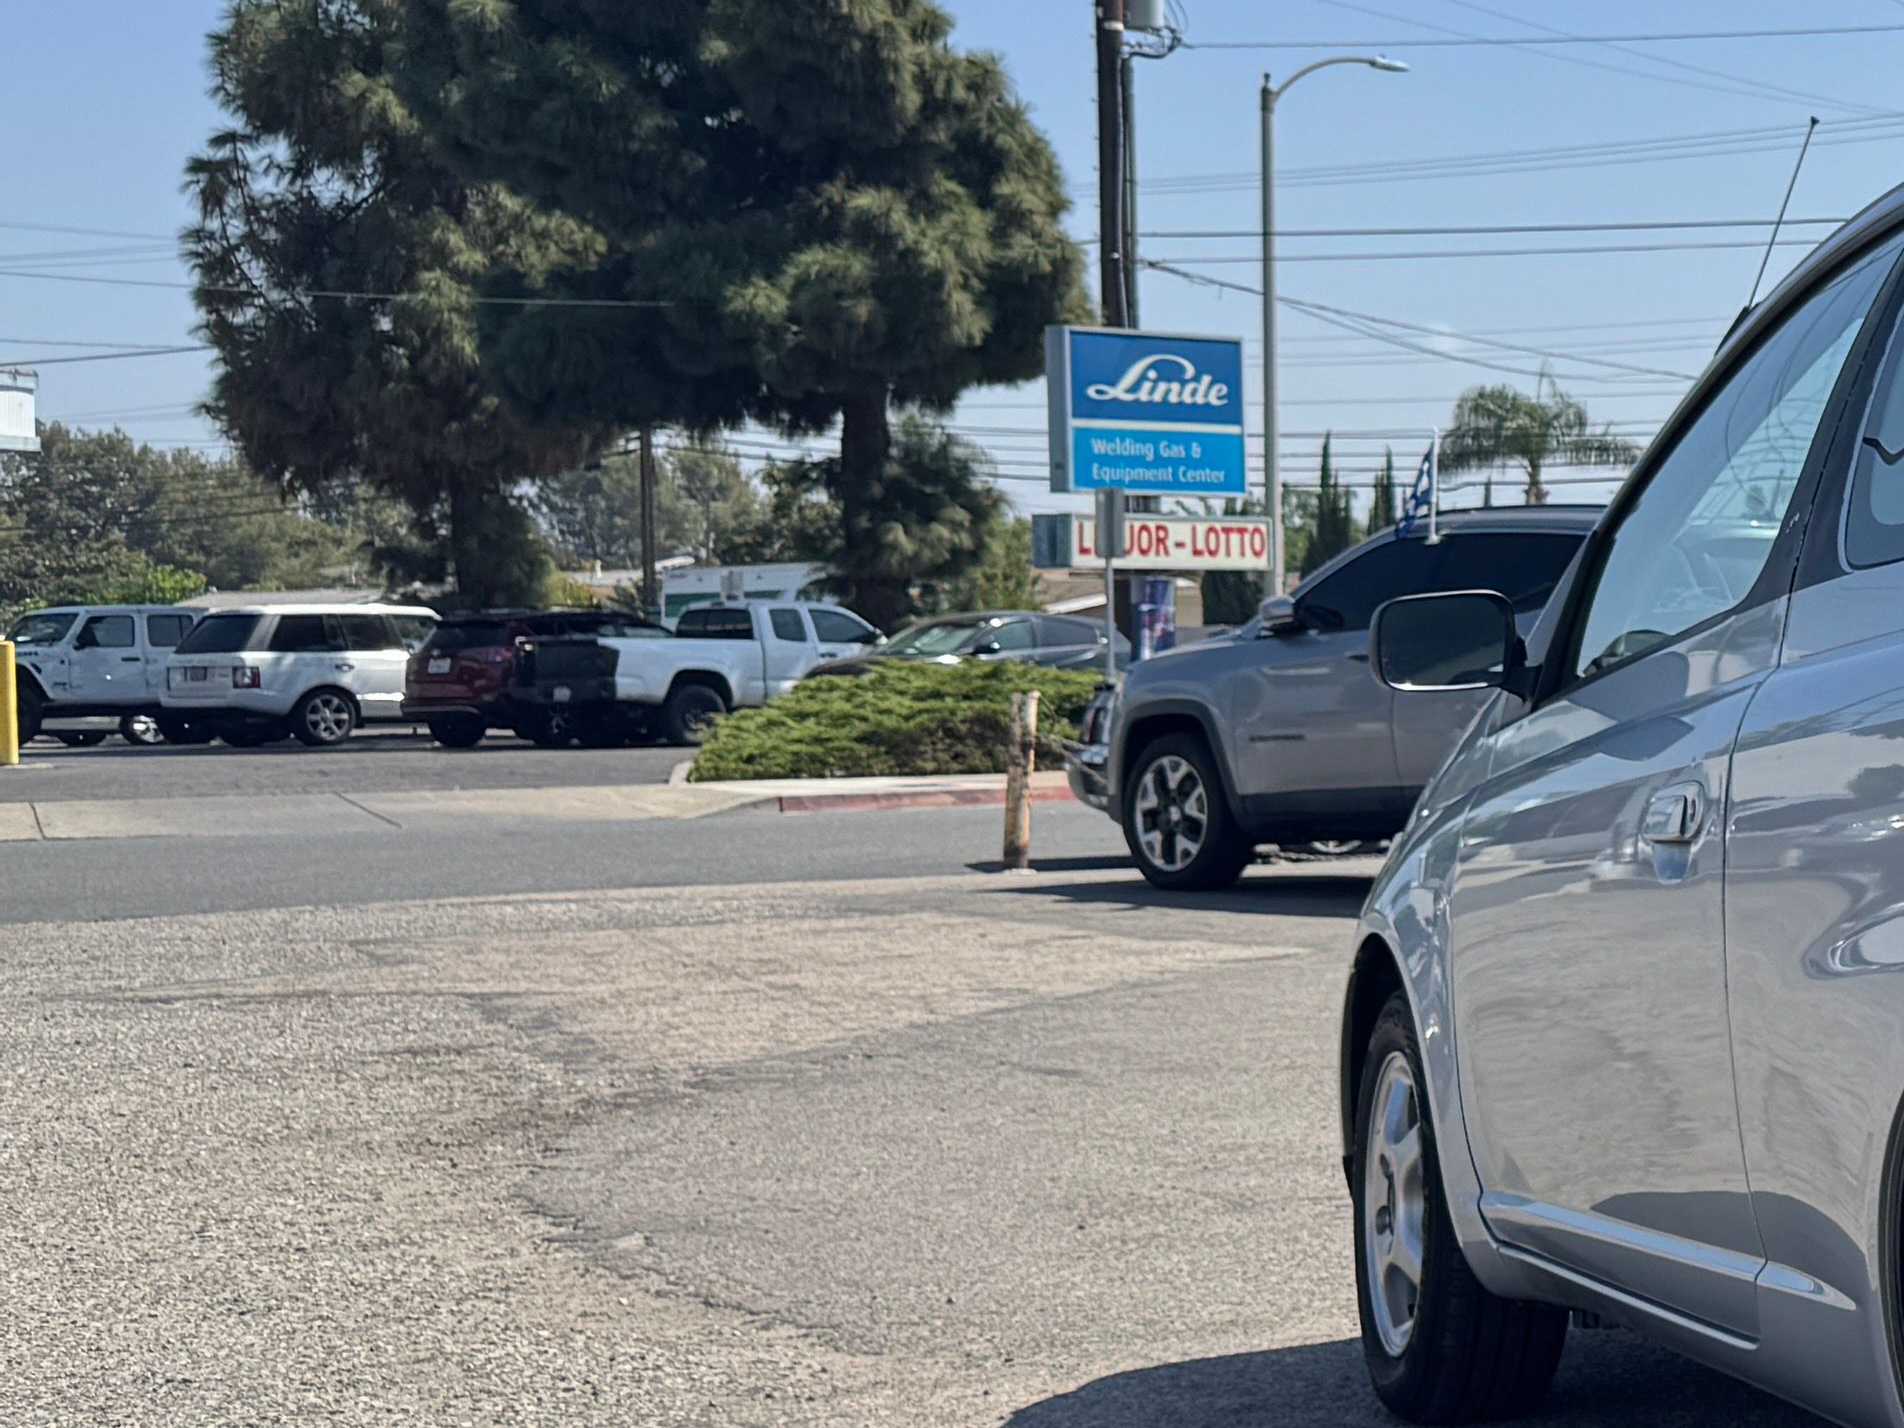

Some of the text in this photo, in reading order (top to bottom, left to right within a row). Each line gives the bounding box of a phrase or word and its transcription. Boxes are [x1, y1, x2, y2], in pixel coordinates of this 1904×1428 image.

[1086, 353, 1229, 406] Linde
[1090, 437, 1202, 462] Welding Gas &
[1092, 462, 1225, 484] Equipment Center
[1191, 523, 1266, 558] LOTTO
